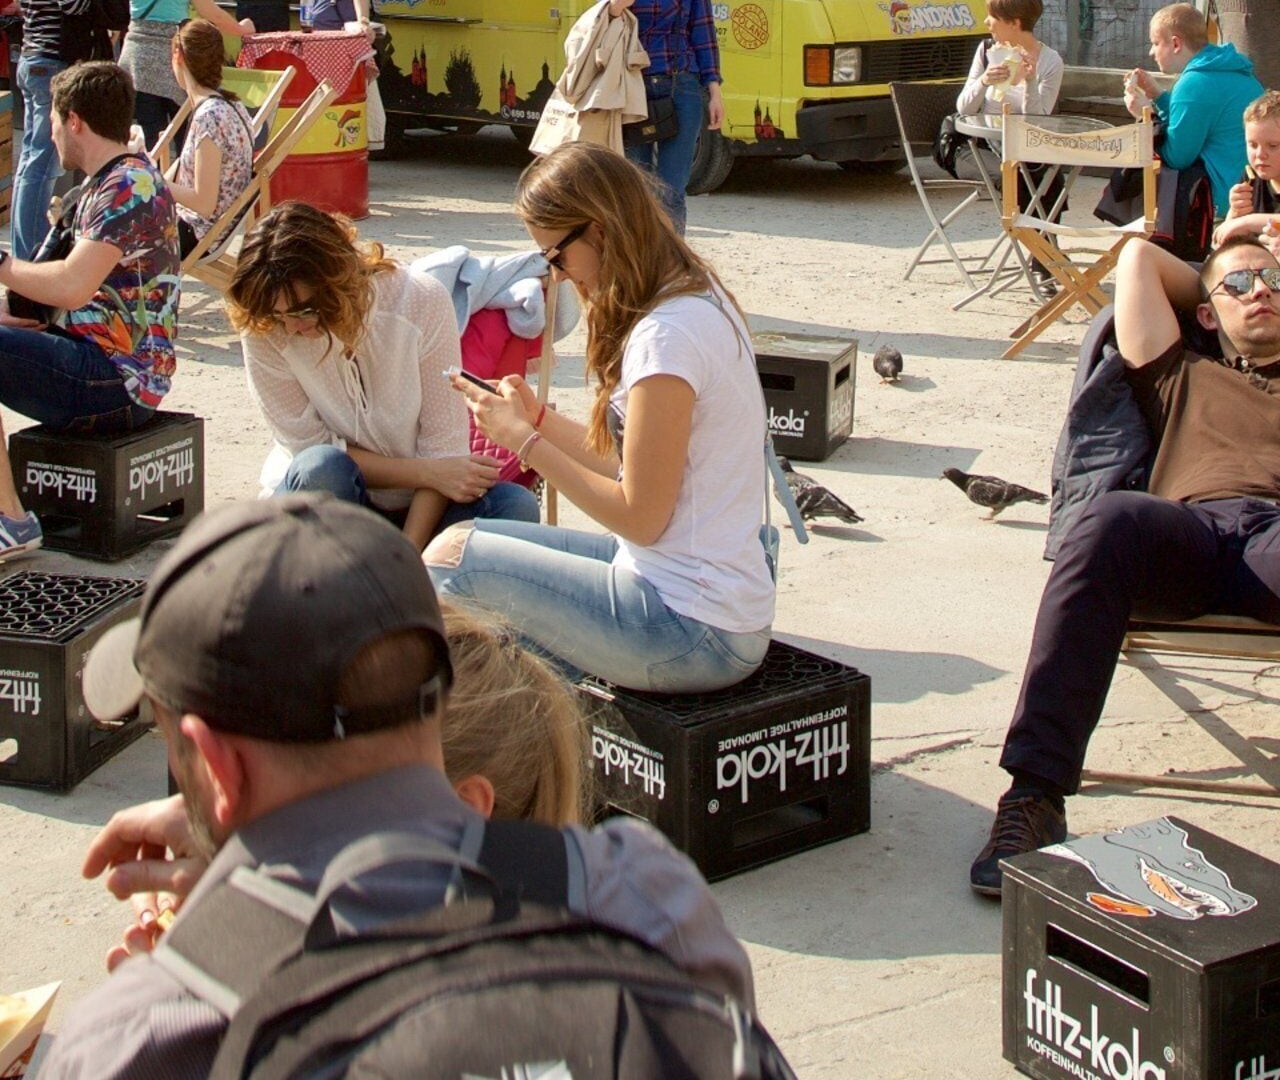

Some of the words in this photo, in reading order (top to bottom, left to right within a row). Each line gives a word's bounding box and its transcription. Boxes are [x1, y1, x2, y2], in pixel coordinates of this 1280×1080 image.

[26, 469, 97, 504] fritz-kola
[130, 447, 195, 501] fritz-kola
[718, 729, 769, 752] LIMONADE
[769, 705, 848, 738] KOFFEINHALTIGE
[592, 735, 666, 800] fritz-kola
[717, 721, 850, 804] fritz-kola
[1026, 1034, 1102, 1080] KOFFEINHALTI
